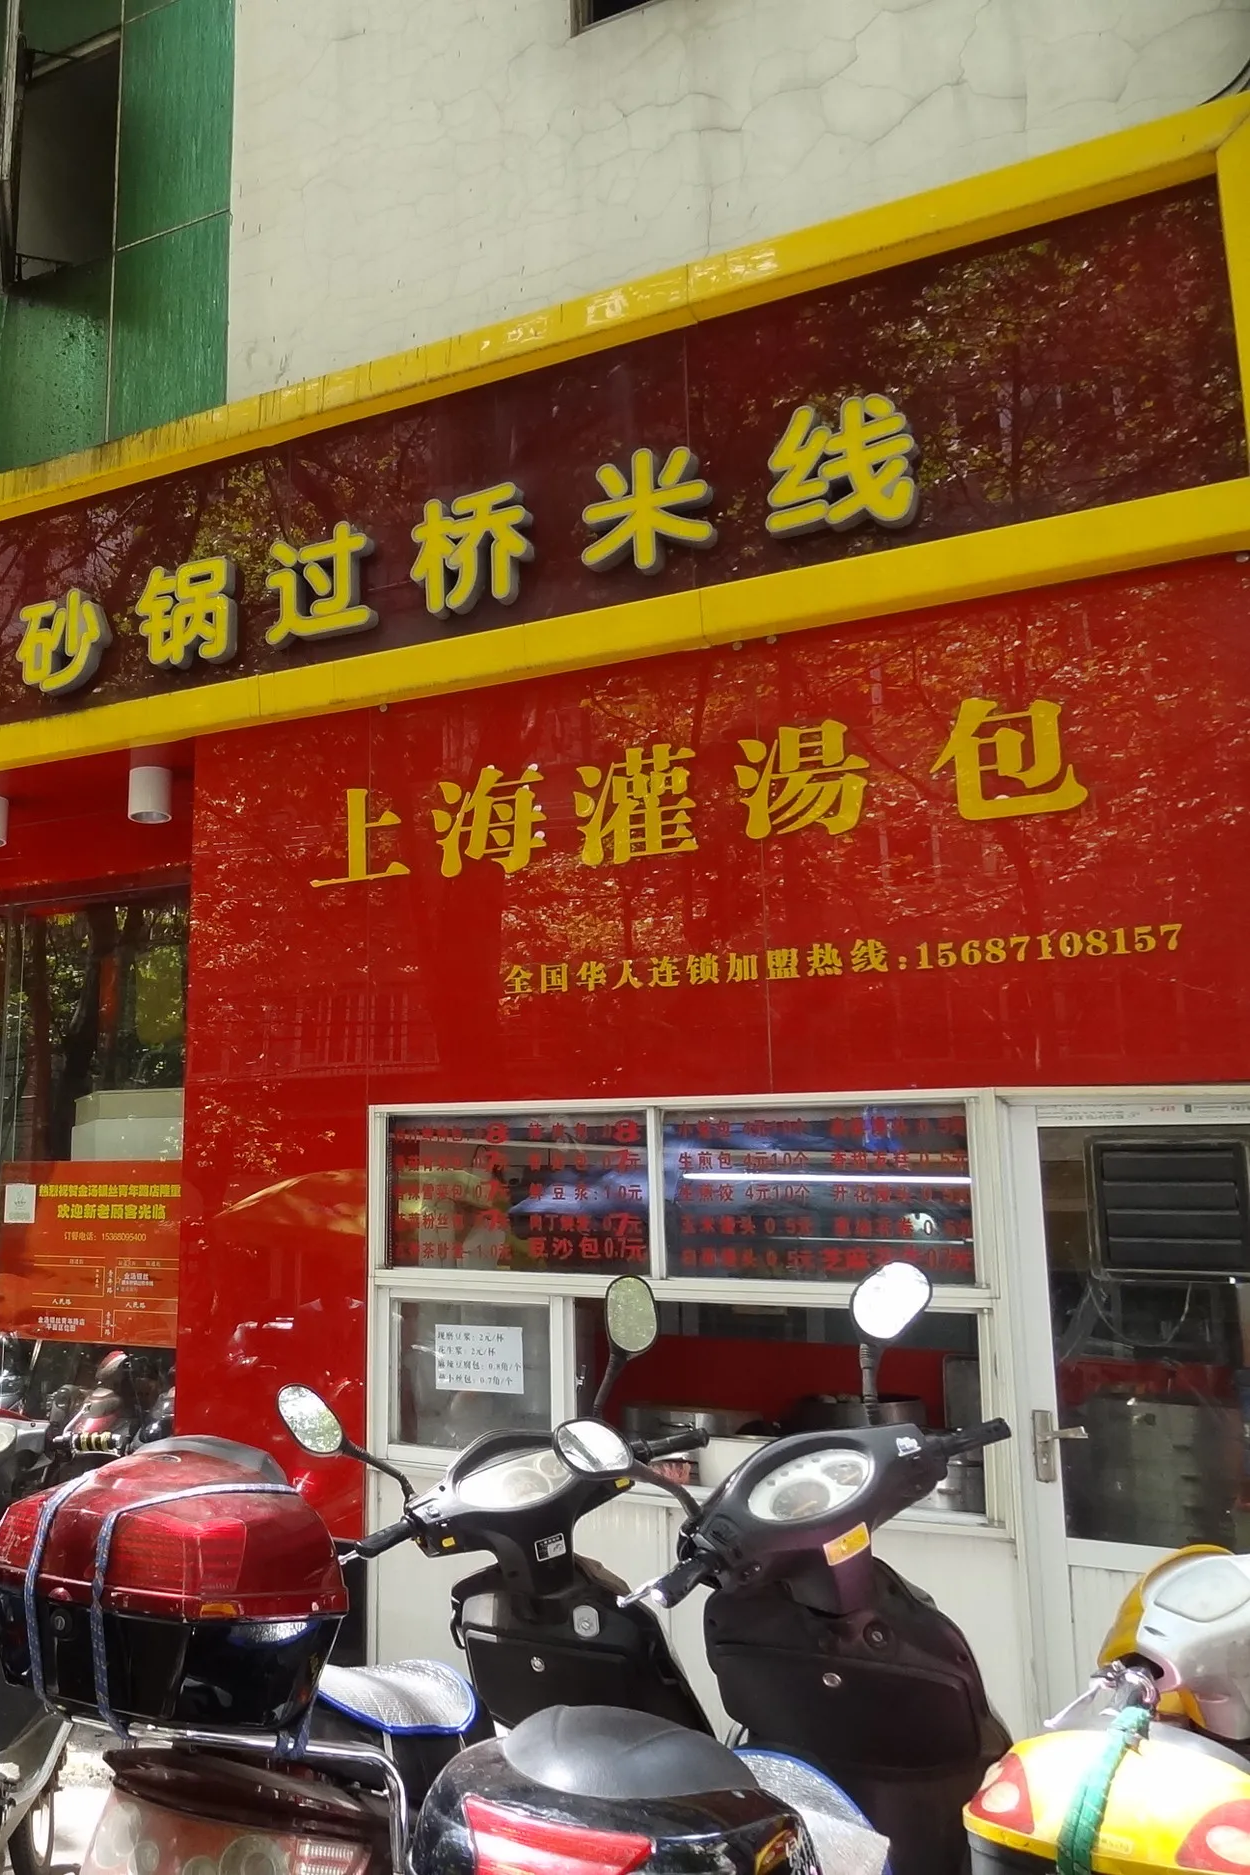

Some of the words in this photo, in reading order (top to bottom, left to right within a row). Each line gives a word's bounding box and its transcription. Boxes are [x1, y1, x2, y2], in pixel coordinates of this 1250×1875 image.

[309, 697, 1089, 891] 上海灌湯包
[56, 1203, 167, 1220] 欢迎新老顾客光临
